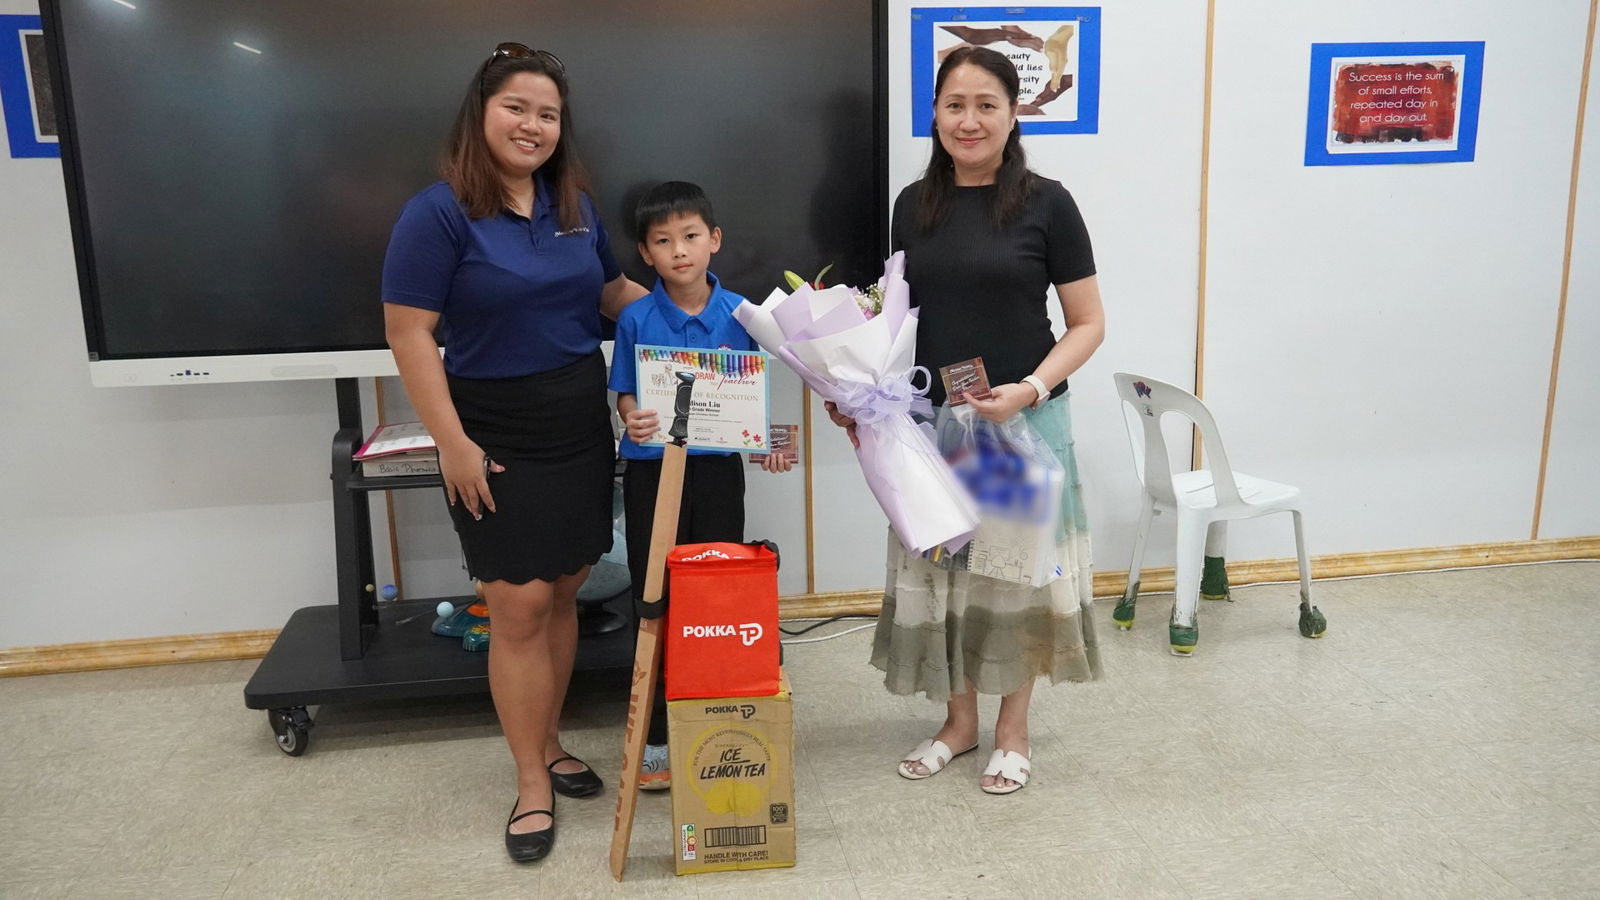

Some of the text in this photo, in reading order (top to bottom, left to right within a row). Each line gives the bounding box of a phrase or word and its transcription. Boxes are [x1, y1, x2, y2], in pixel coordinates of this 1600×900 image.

[1349, 72, 1392, 82] Success
[1406, 72, 1422, 80] the
[1358, 85, 1433, 95] of small efforts,
[1350, 99, 1438, 110] repeated day in
[1360, 113, 1427, 123] and day out.
[695, 371, 758, 390] DRAW Teacher
[646, 389, 676, 398] CERTIFIC
[706, 392, 759, 401] RECOGNITION
[683, 625, 736, 638] POKKA
[705, 705, 739, 715] POKKA
[720, 748, 742, 763] ICE
[700, 763, 766, 779] LEMON TEA
[704, 852, 730, 860] HANDLE
